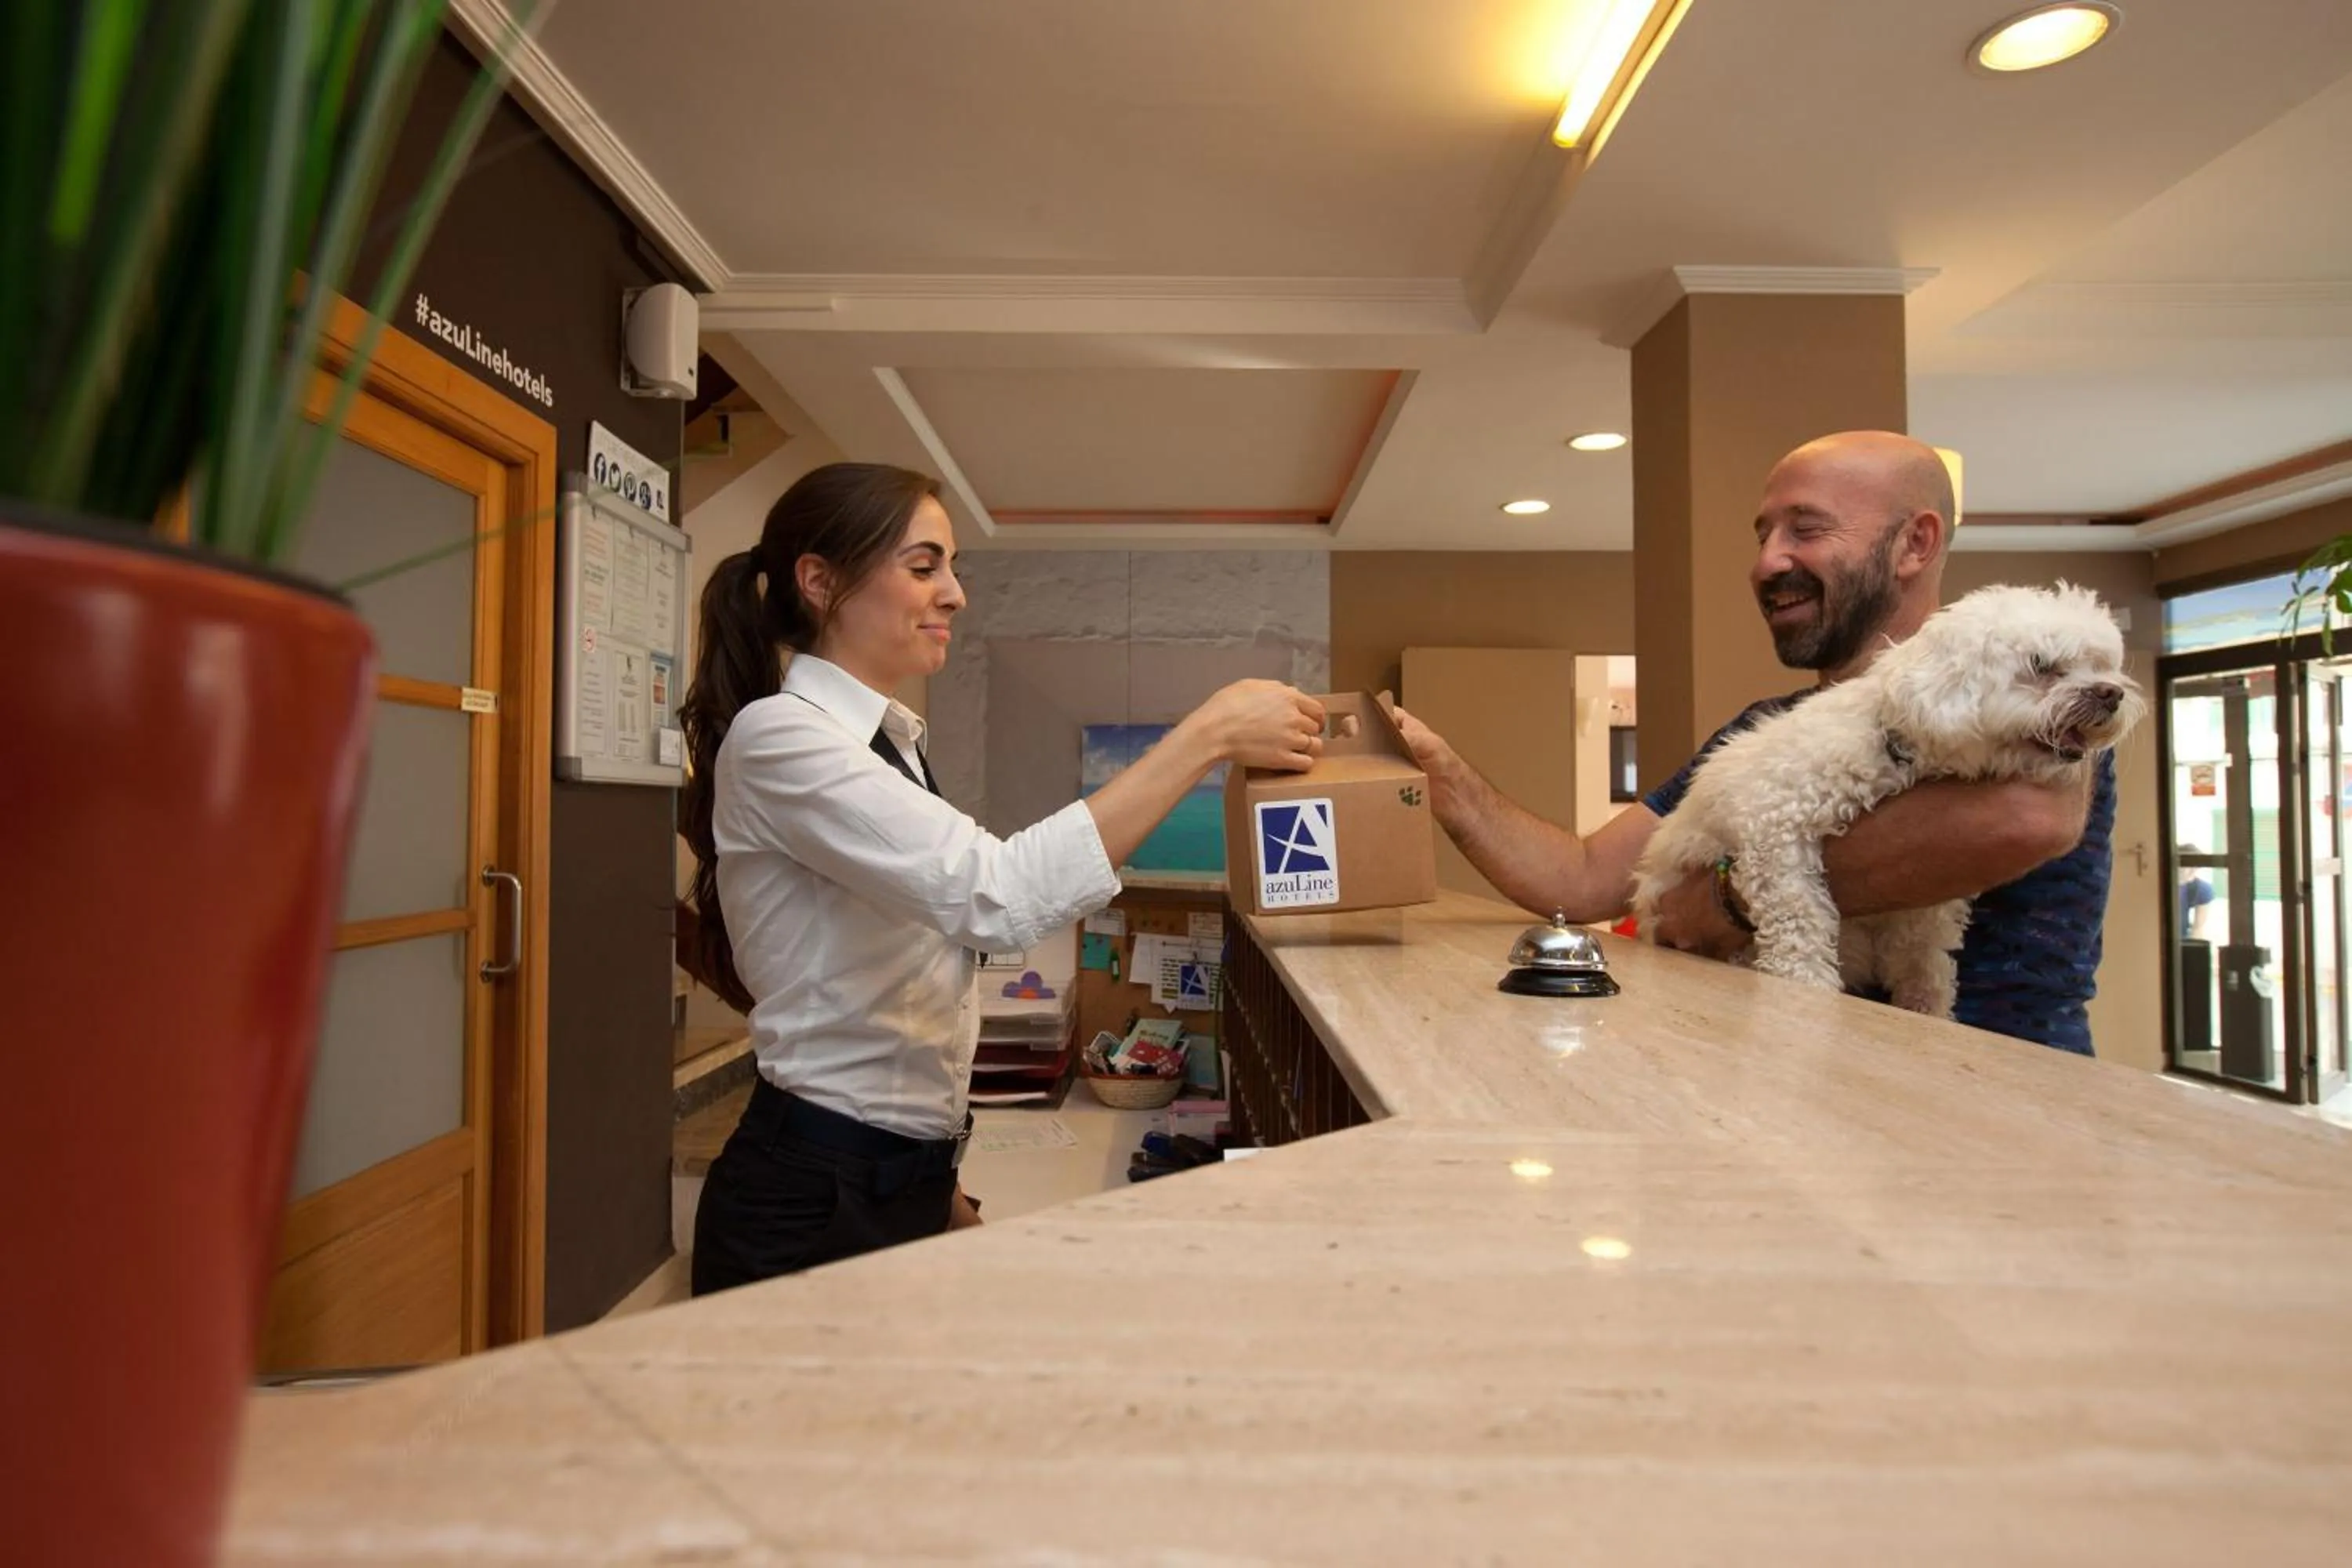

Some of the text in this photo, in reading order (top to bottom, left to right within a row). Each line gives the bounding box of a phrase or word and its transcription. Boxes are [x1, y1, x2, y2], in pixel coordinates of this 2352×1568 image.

[416, 293, 554, 408] #azuLinehotels
[1266, 874, 1334, 894] azuLine
[1267, 891, 1334, 903] HOTELS
